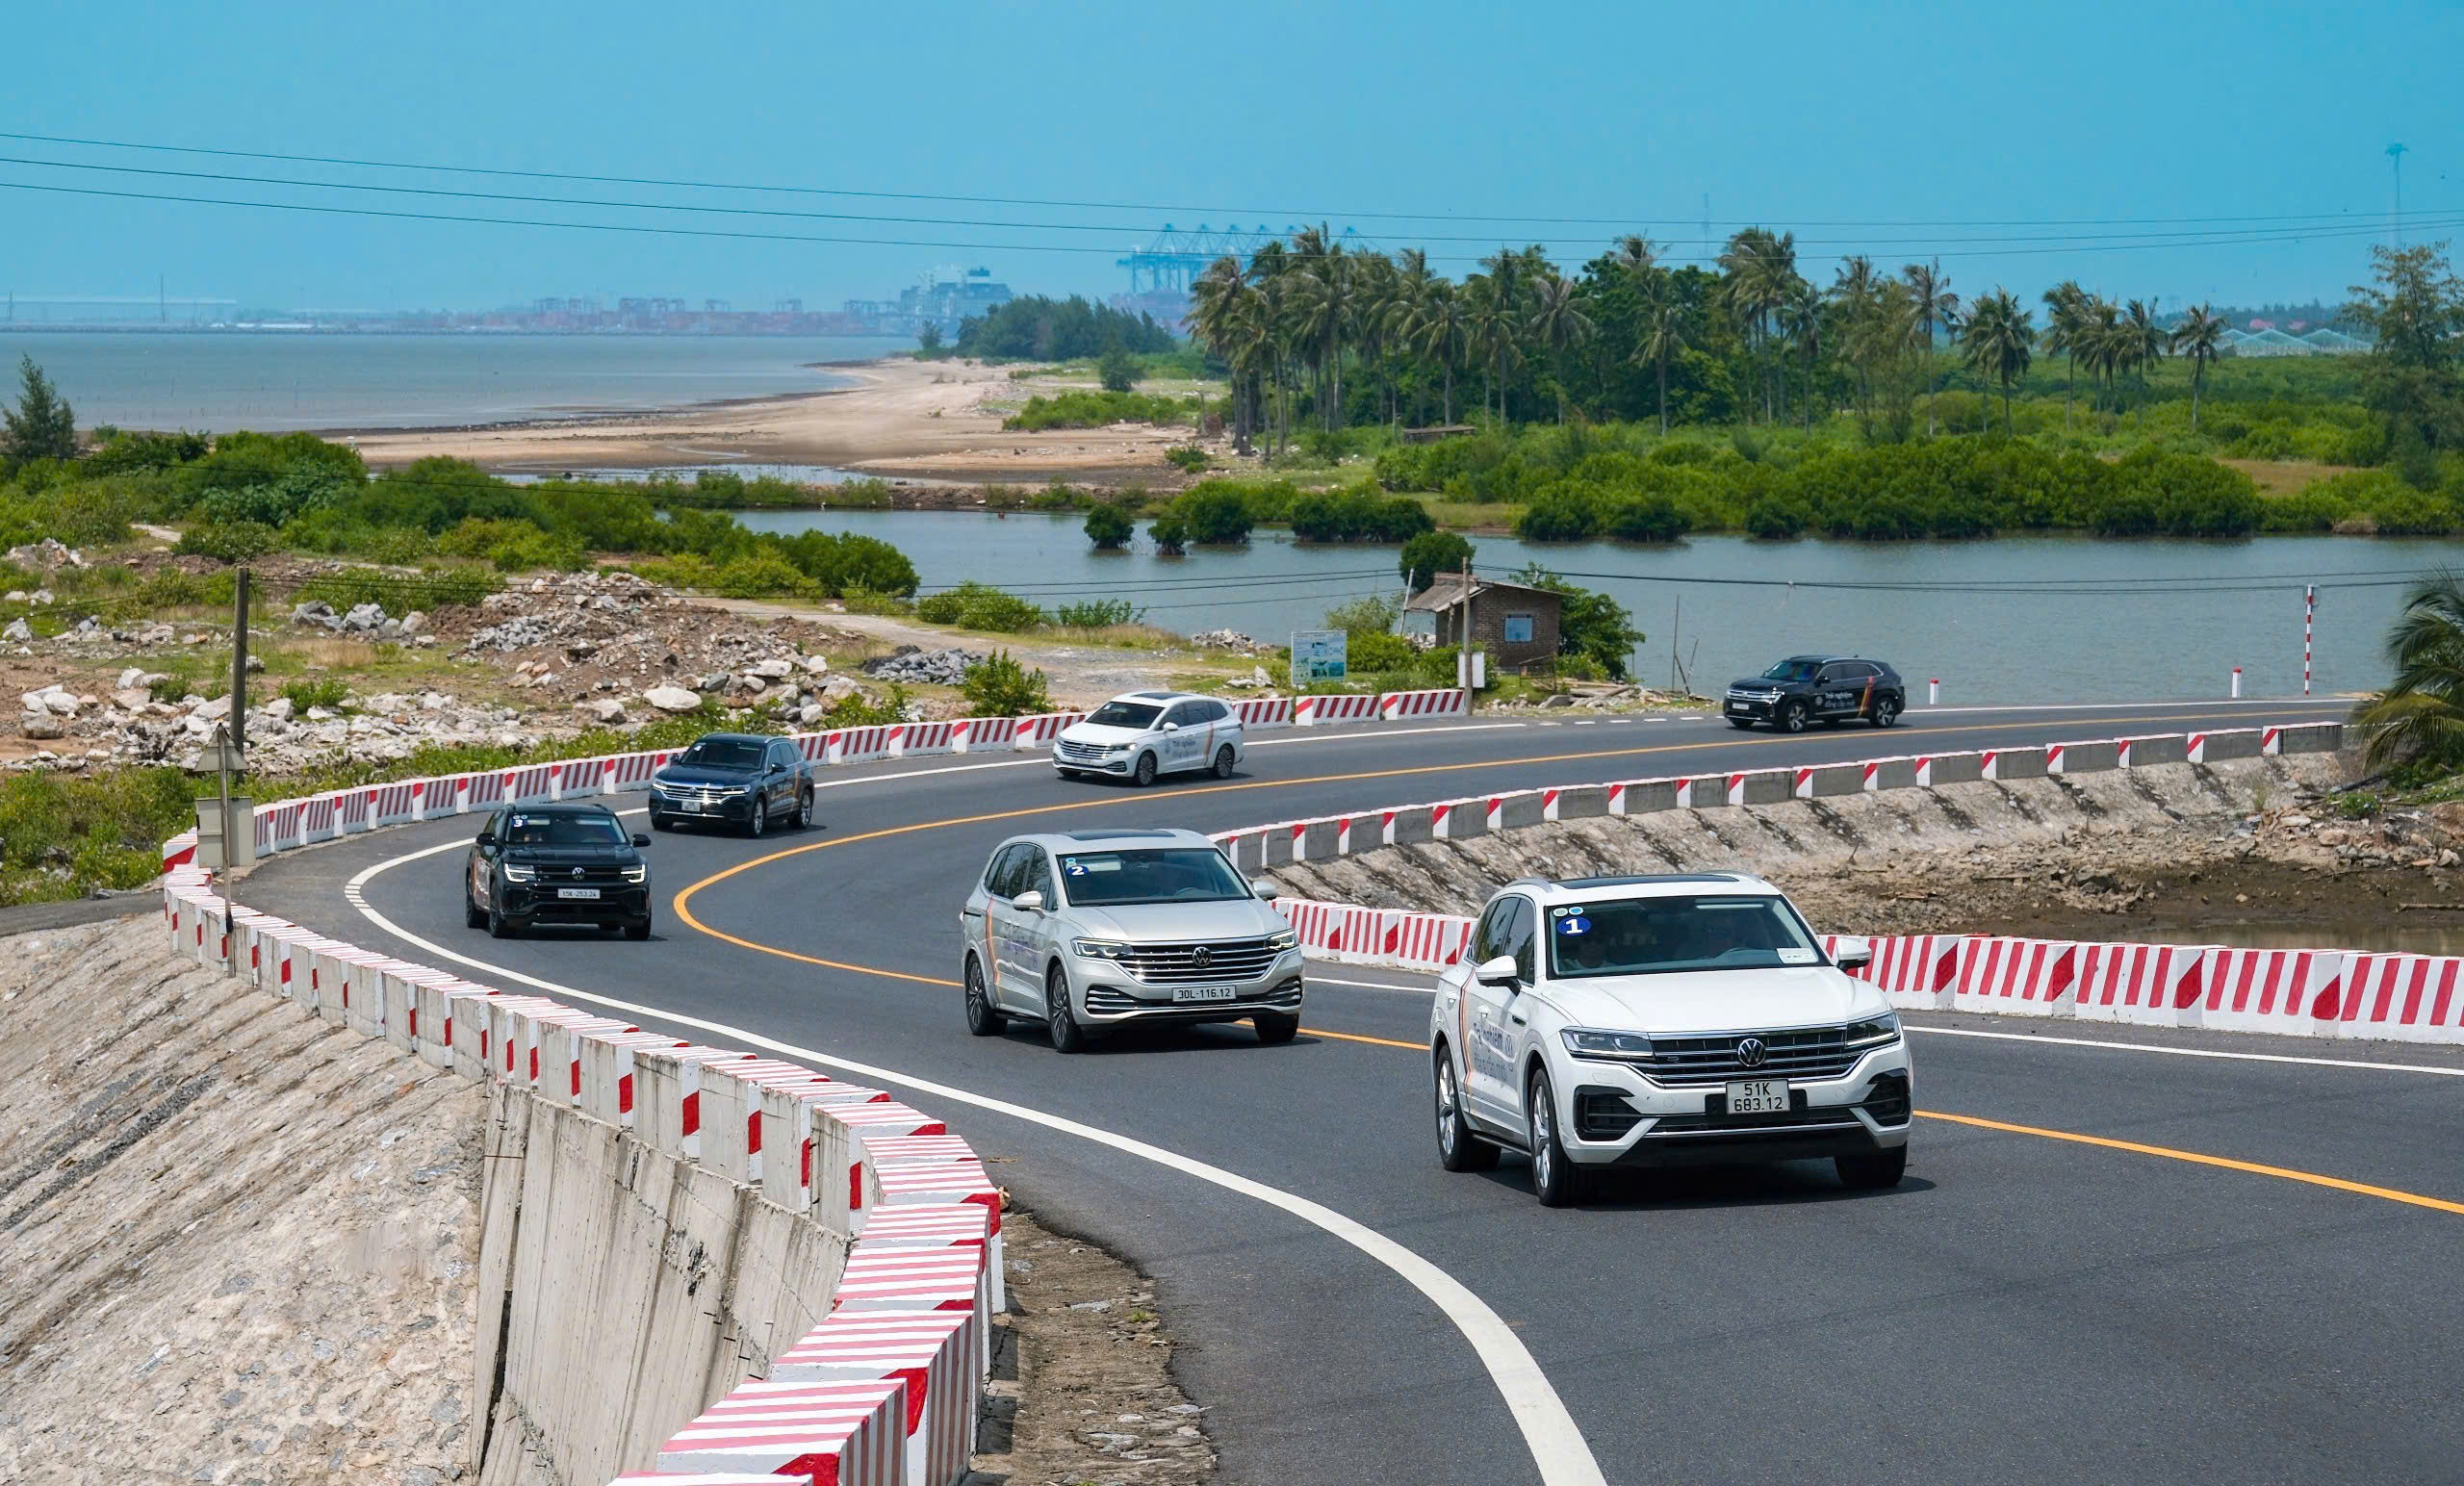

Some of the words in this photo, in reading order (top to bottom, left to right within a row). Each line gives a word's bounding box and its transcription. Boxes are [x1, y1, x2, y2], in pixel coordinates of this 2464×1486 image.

[513, 819, 524, 828] 3
[1070, 865, 1085, 876] 2
[1565, 918, 1583, 935] 1
[1178, 987, 1231, 999] 30L-116.12
[1744, 1082, 1771, 1096] 51K
[1733, 1096, 1784, 1112] 683.12
